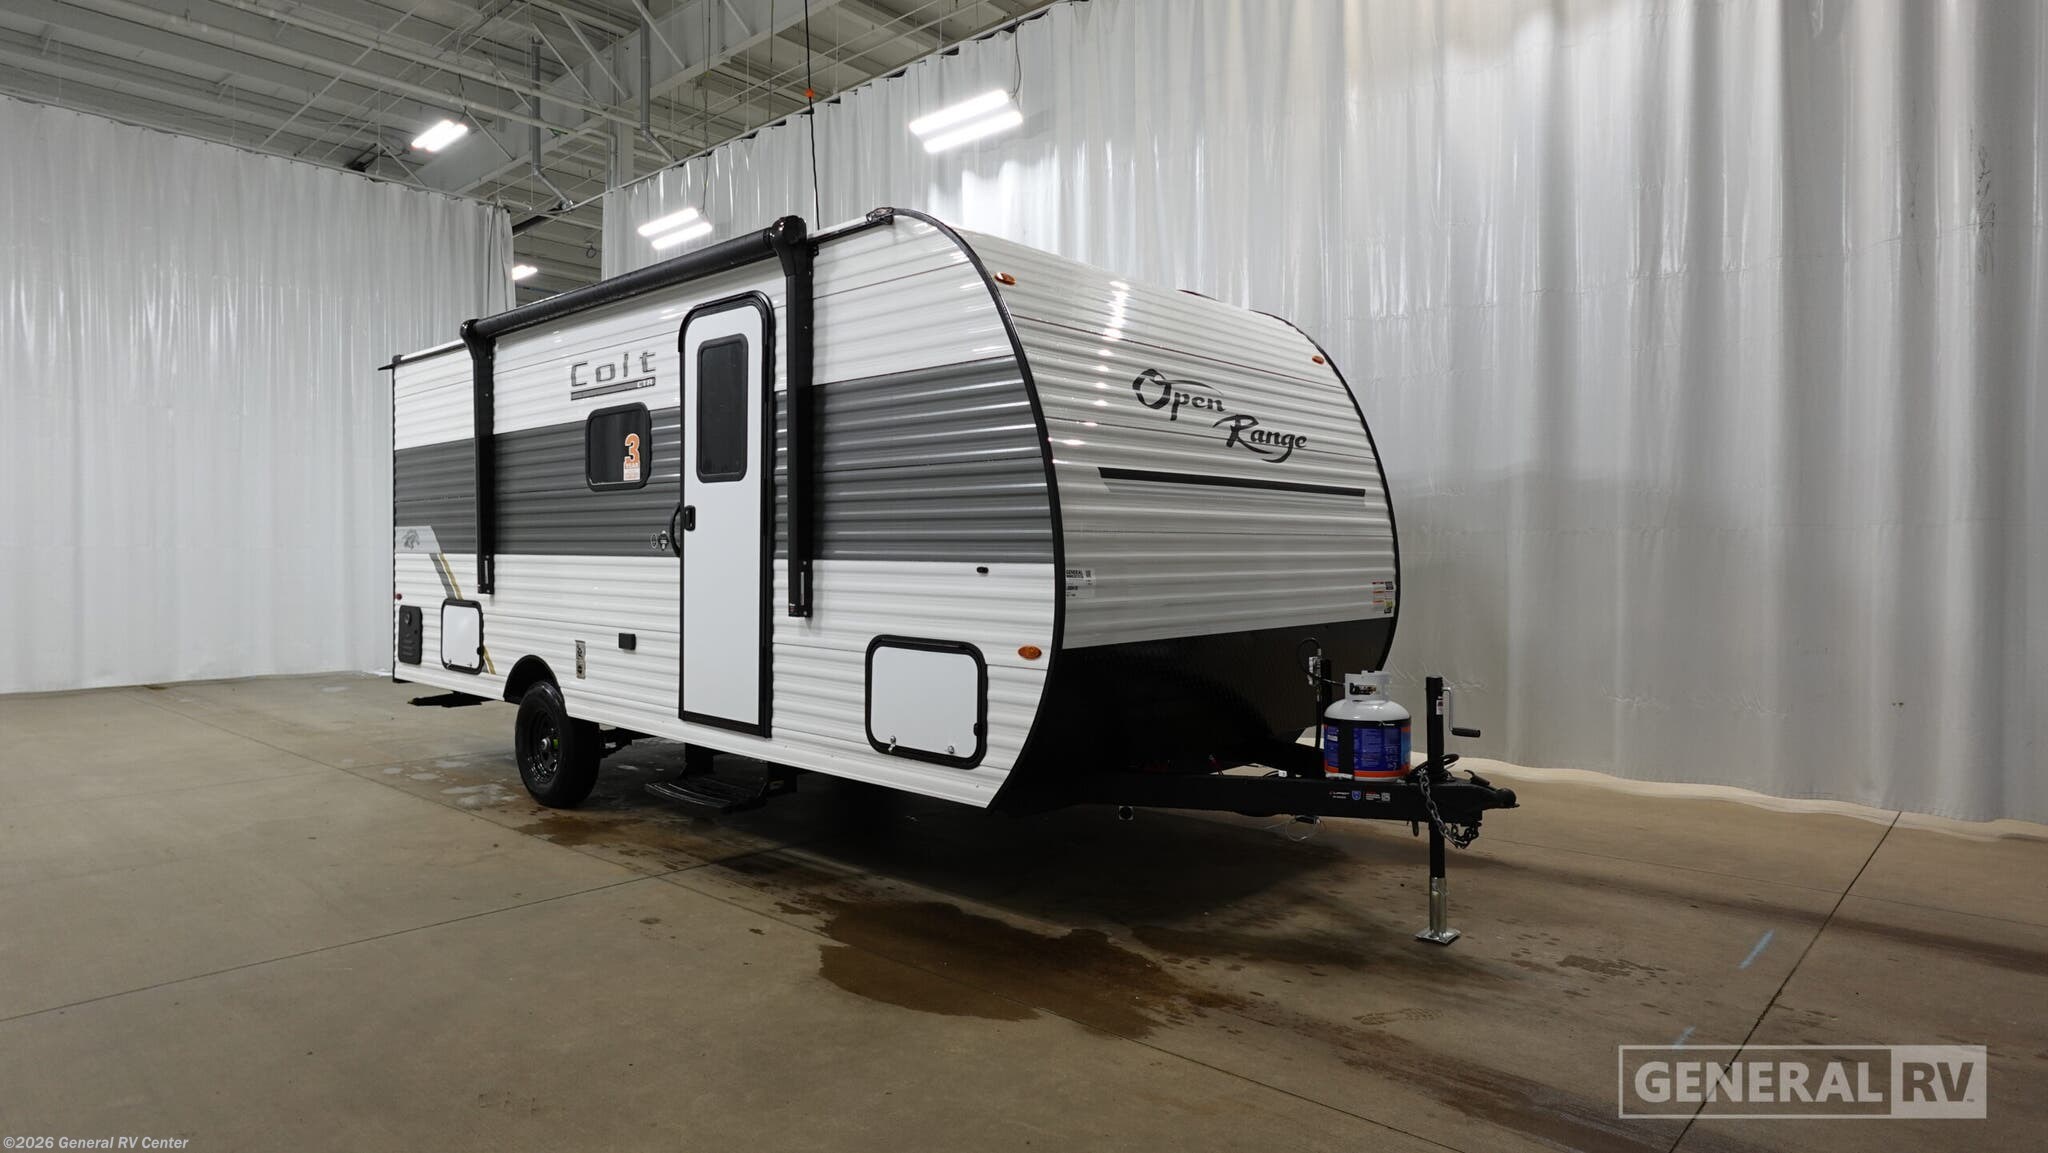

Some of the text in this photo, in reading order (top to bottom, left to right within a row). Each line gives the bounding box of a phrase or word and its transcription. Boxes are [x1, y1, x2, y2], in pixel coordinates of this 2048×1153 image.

[571, 352, 656, 387] Colt
[1132, 368, 1226, 421] Open
[624, 433, 640, 464] 3
[1212, 414, 1307, 463] Range
